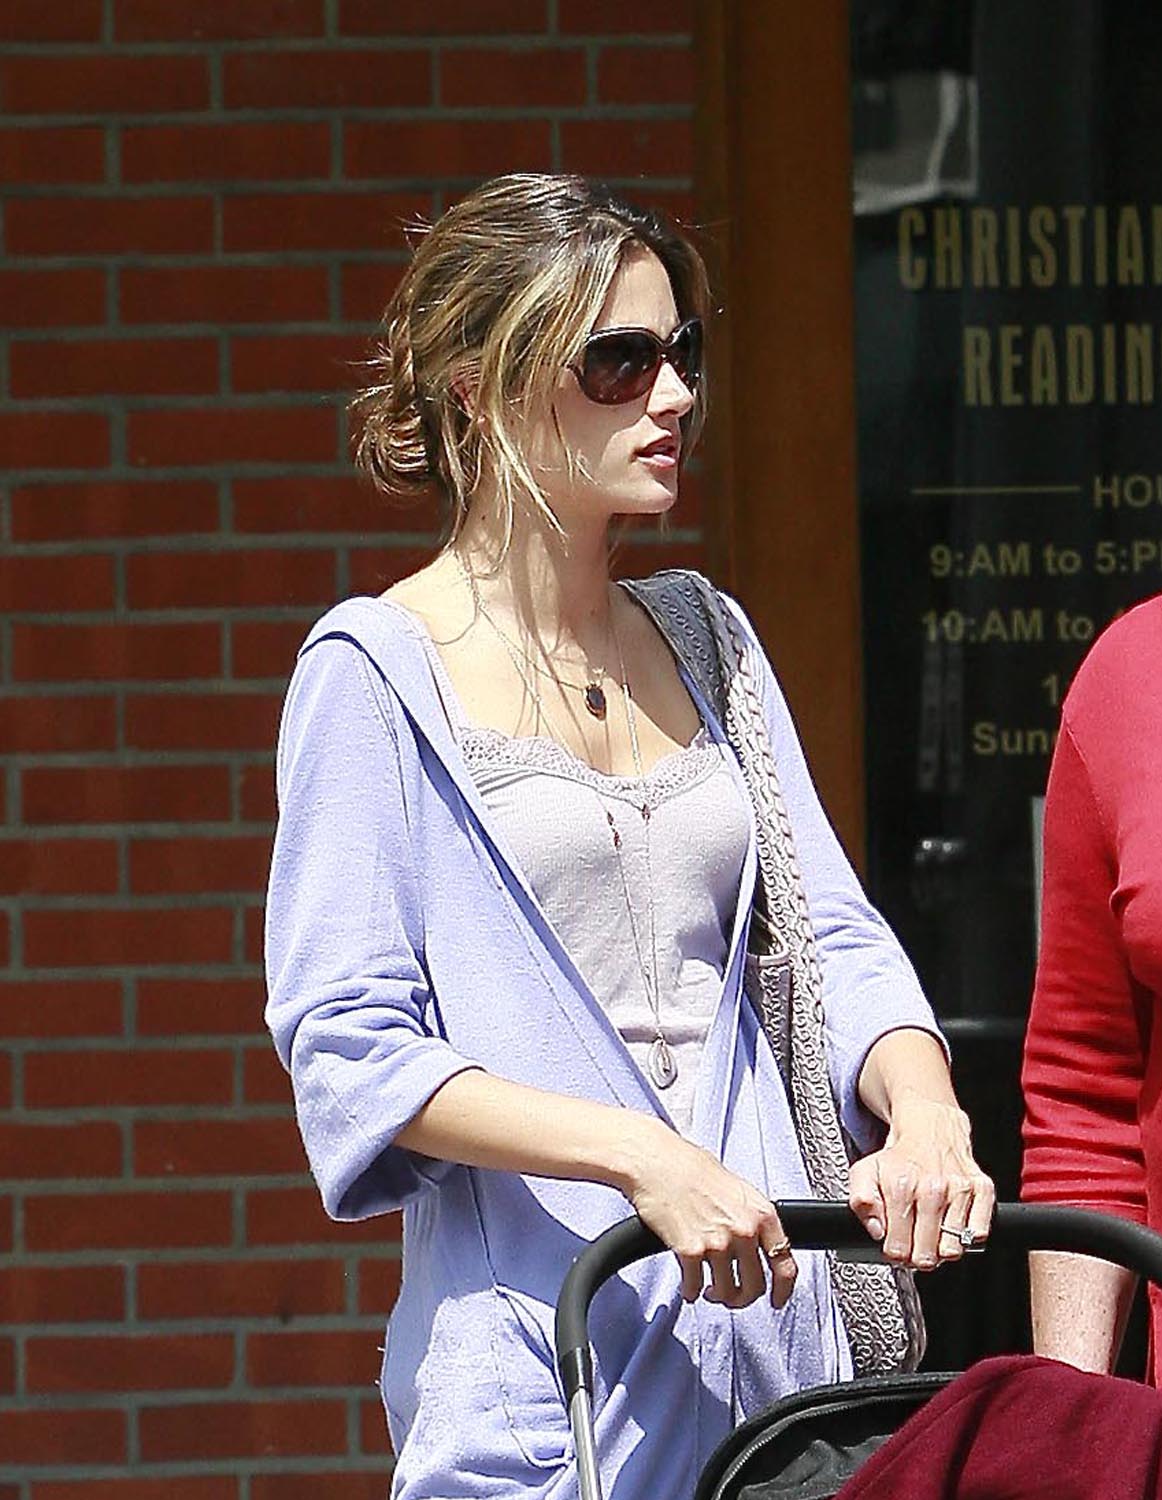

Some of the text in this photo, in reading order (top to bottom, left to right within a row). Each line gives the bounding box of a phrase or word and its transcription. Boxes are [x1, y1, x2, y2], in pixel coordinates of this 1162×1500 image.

[930, 543, 1031, 577] 9:AM
[1044, 545, 1082, 575] to
[922, 609, 1095, 642] 10:AM to
[973, 722, 1056, 755] Sun
